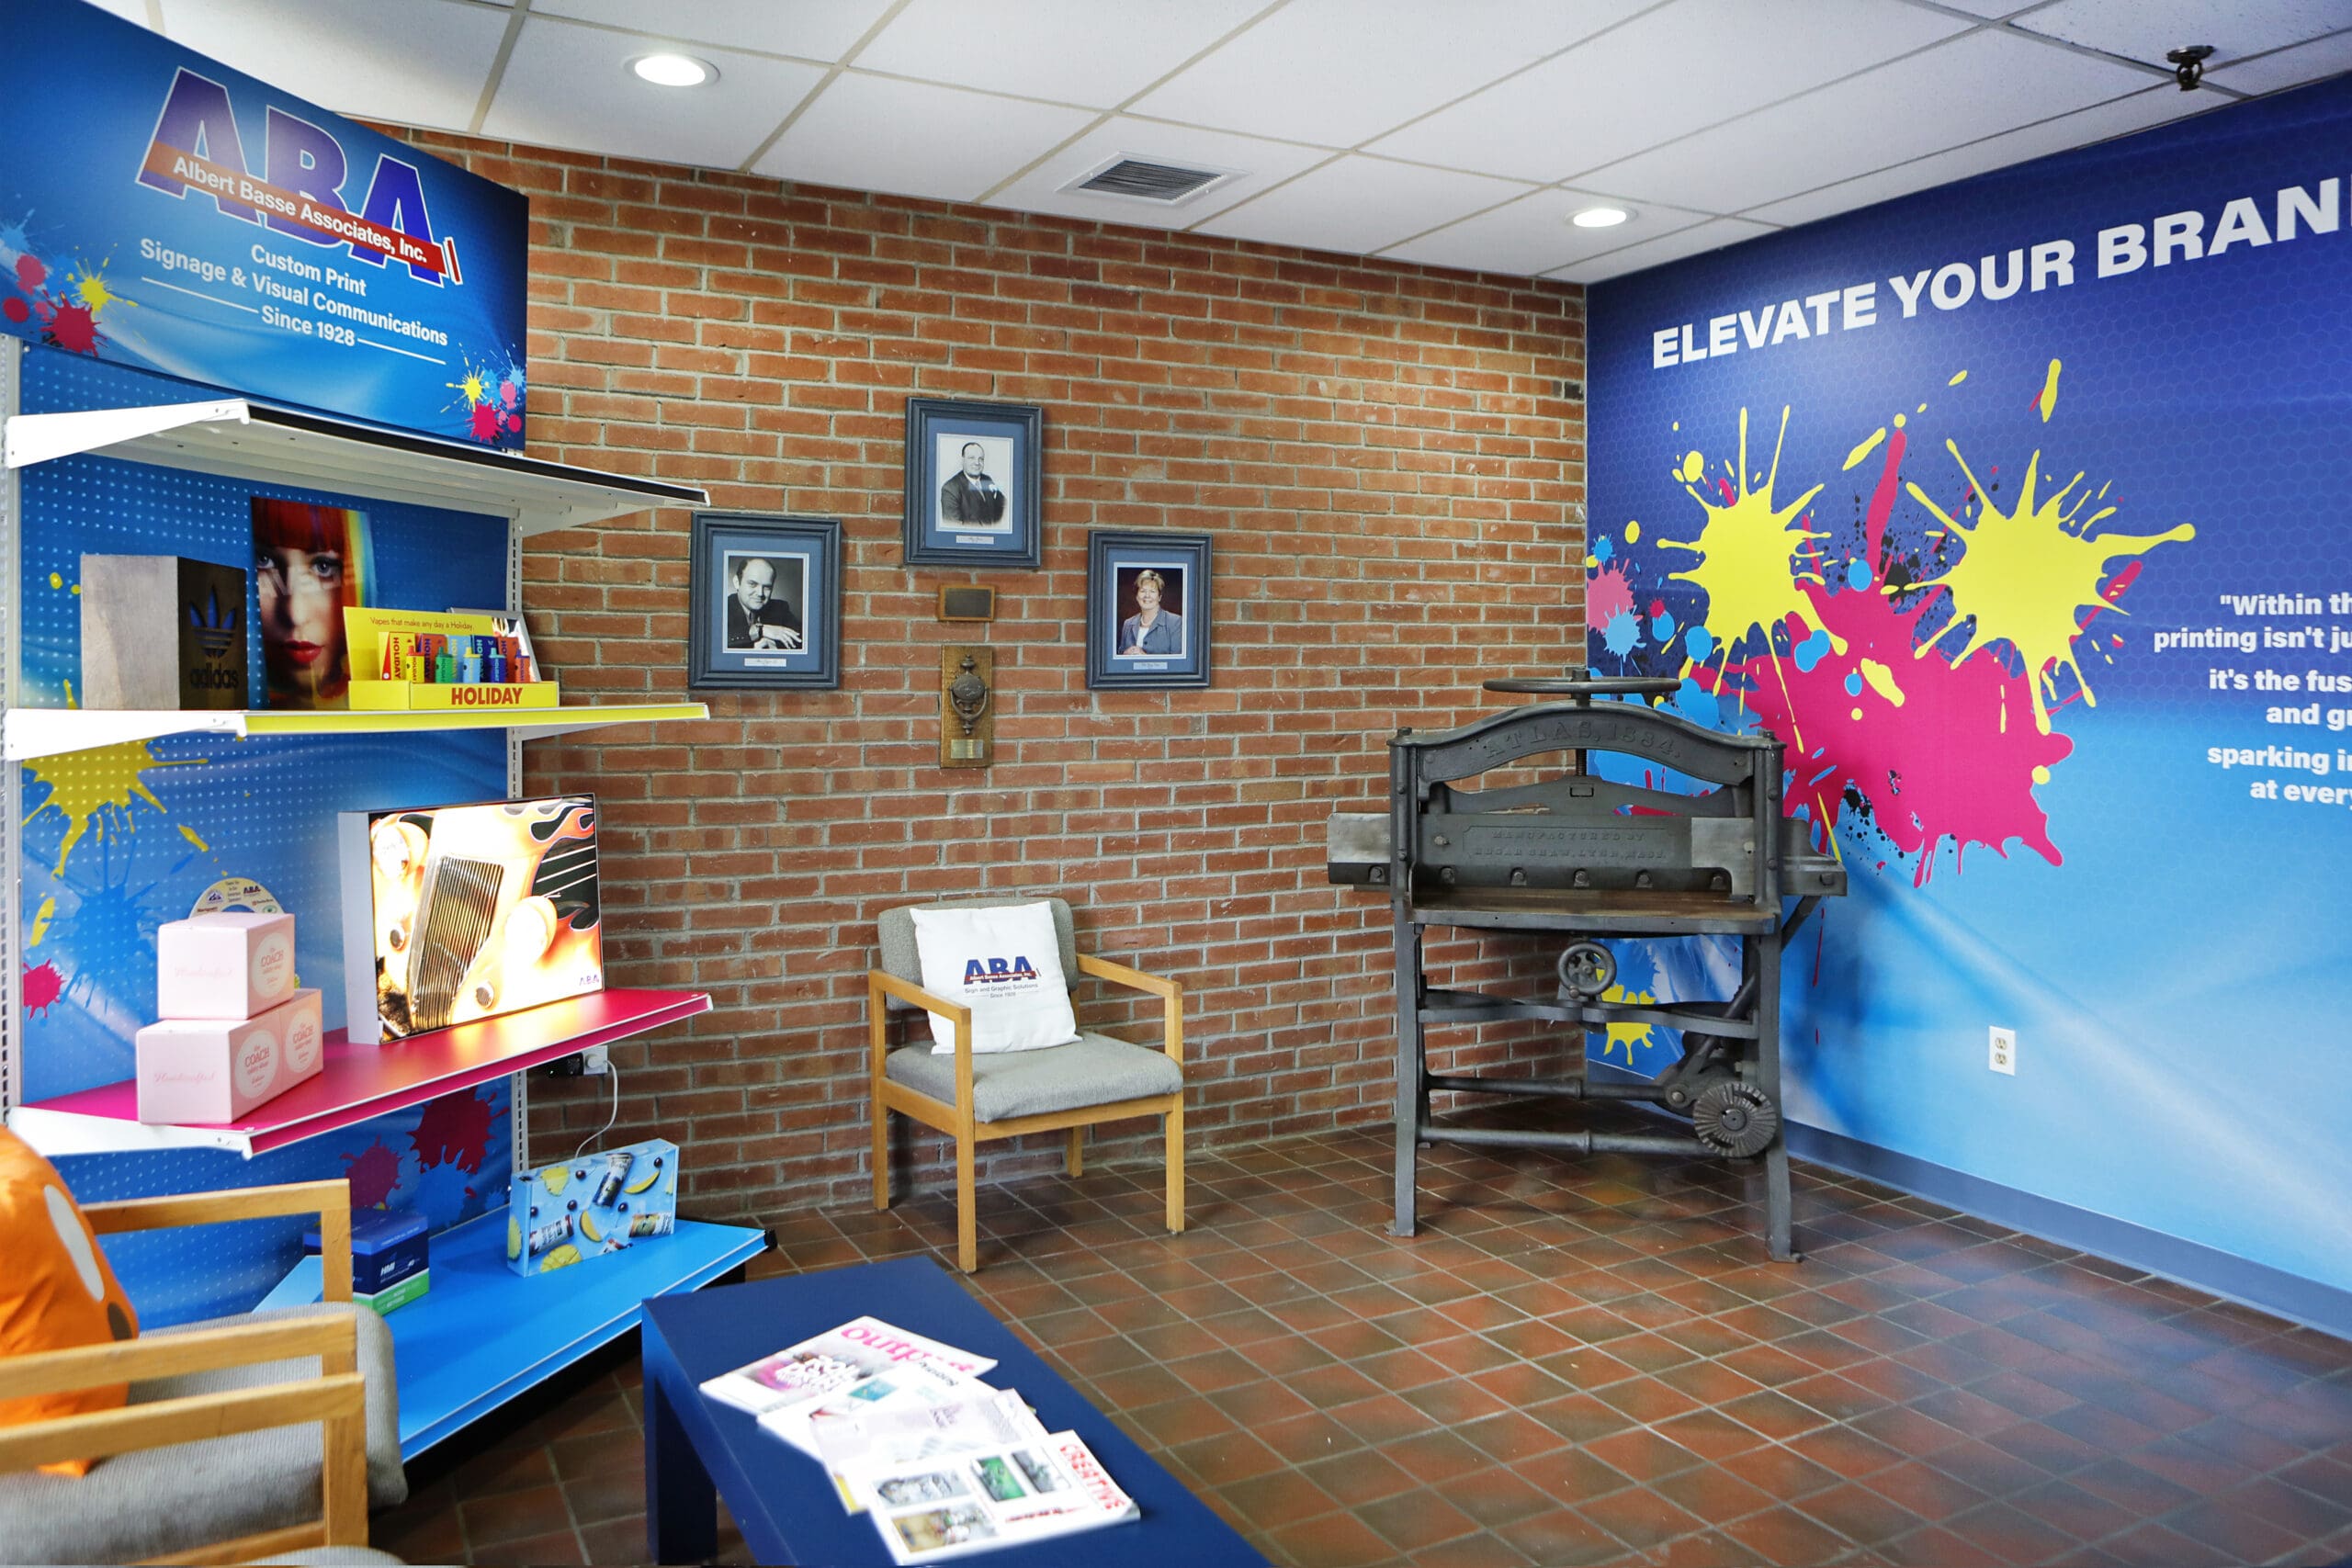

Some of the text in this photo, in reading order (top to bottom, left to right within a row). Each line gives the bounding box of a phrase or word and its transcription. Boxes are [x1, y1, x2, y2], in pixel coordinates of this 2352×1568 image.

[136, 65, 445, 288] ABA
[172, 157, 427, 263] Albert Basse Associates, Inc.
[251, 243, 367, 298] Custom Print
[1654, 174, 2352, 368] ELEVATE YOUR BRAN
[140, 237, 448, 346] Signage & Visual Communications
[262, 305, 356, 346] Since 1928
[2220, 593, 2323, 615] "Within
[2154, 626, 2257, 653] printing
[2264, 626, 2325, 649] isn't
[393, 637, 401, 680] HOLIDAY
[190, 662, 239, 689] adidas
[2209, 668, 2352, 693] it's the fus
[451, 688, 523, 705] HOLIDAY
[2266, 703, 2320, 725] and
[2207, 745, 2352, 775] sparking i
[2250, 780, 2352, 811] at ever
[261, 950, 284, 967] COACH
[964, 956, 1036, 985] ABA
[293, 1025, 313, 1043] COACH
[244, 1046, 270, 1067] COACH
